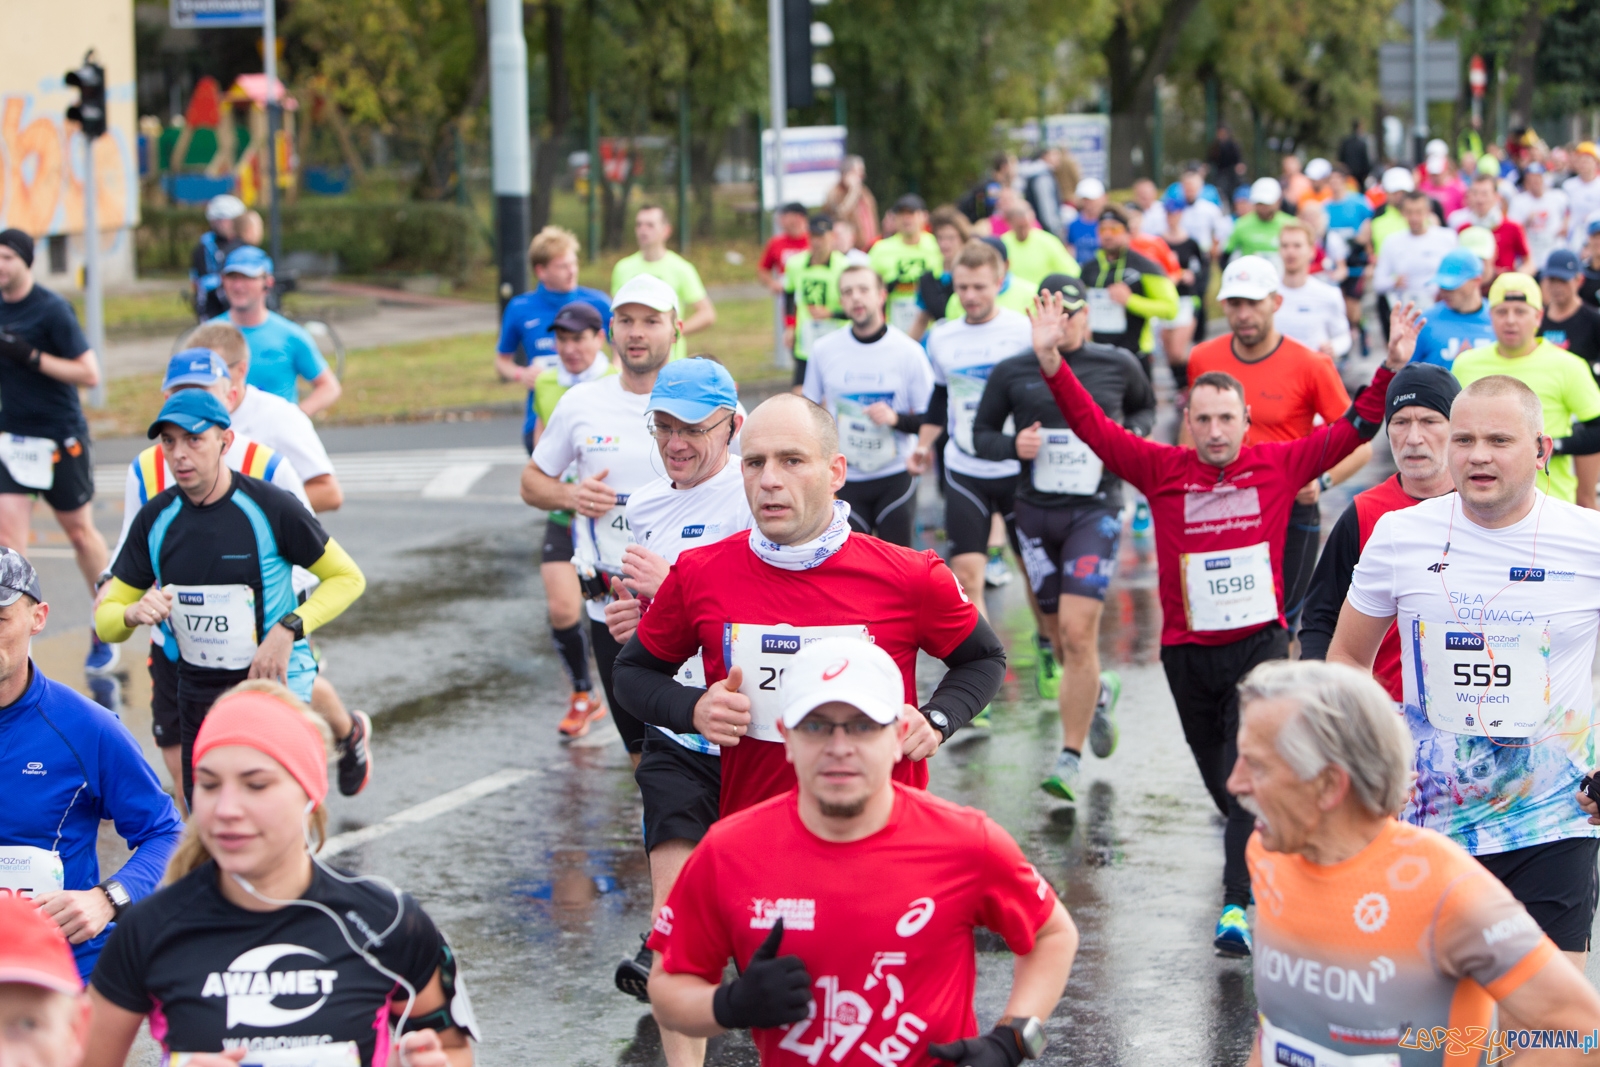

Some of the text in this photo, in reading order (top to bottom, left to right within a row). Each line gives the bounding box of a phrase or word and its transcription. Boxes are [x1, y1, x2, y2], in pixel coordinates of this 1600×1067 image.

[1427, 562, 1450, 574] 4F
[1207, 574, 1256, 596] 1698
[1448, 591, 1485, 606] SIŁA
[183, 614, 230, 633] 1778
[1457, 607, 1535, 623] ODWAGA
[758, 666, 786, 691] 2
[1453, 663, 1512, 687] 559
[1456, 692, 1510, 705] Wojciech
[22, 769, 48, 777] Kalenji
[201, 969, 338, 998] AWAMET
